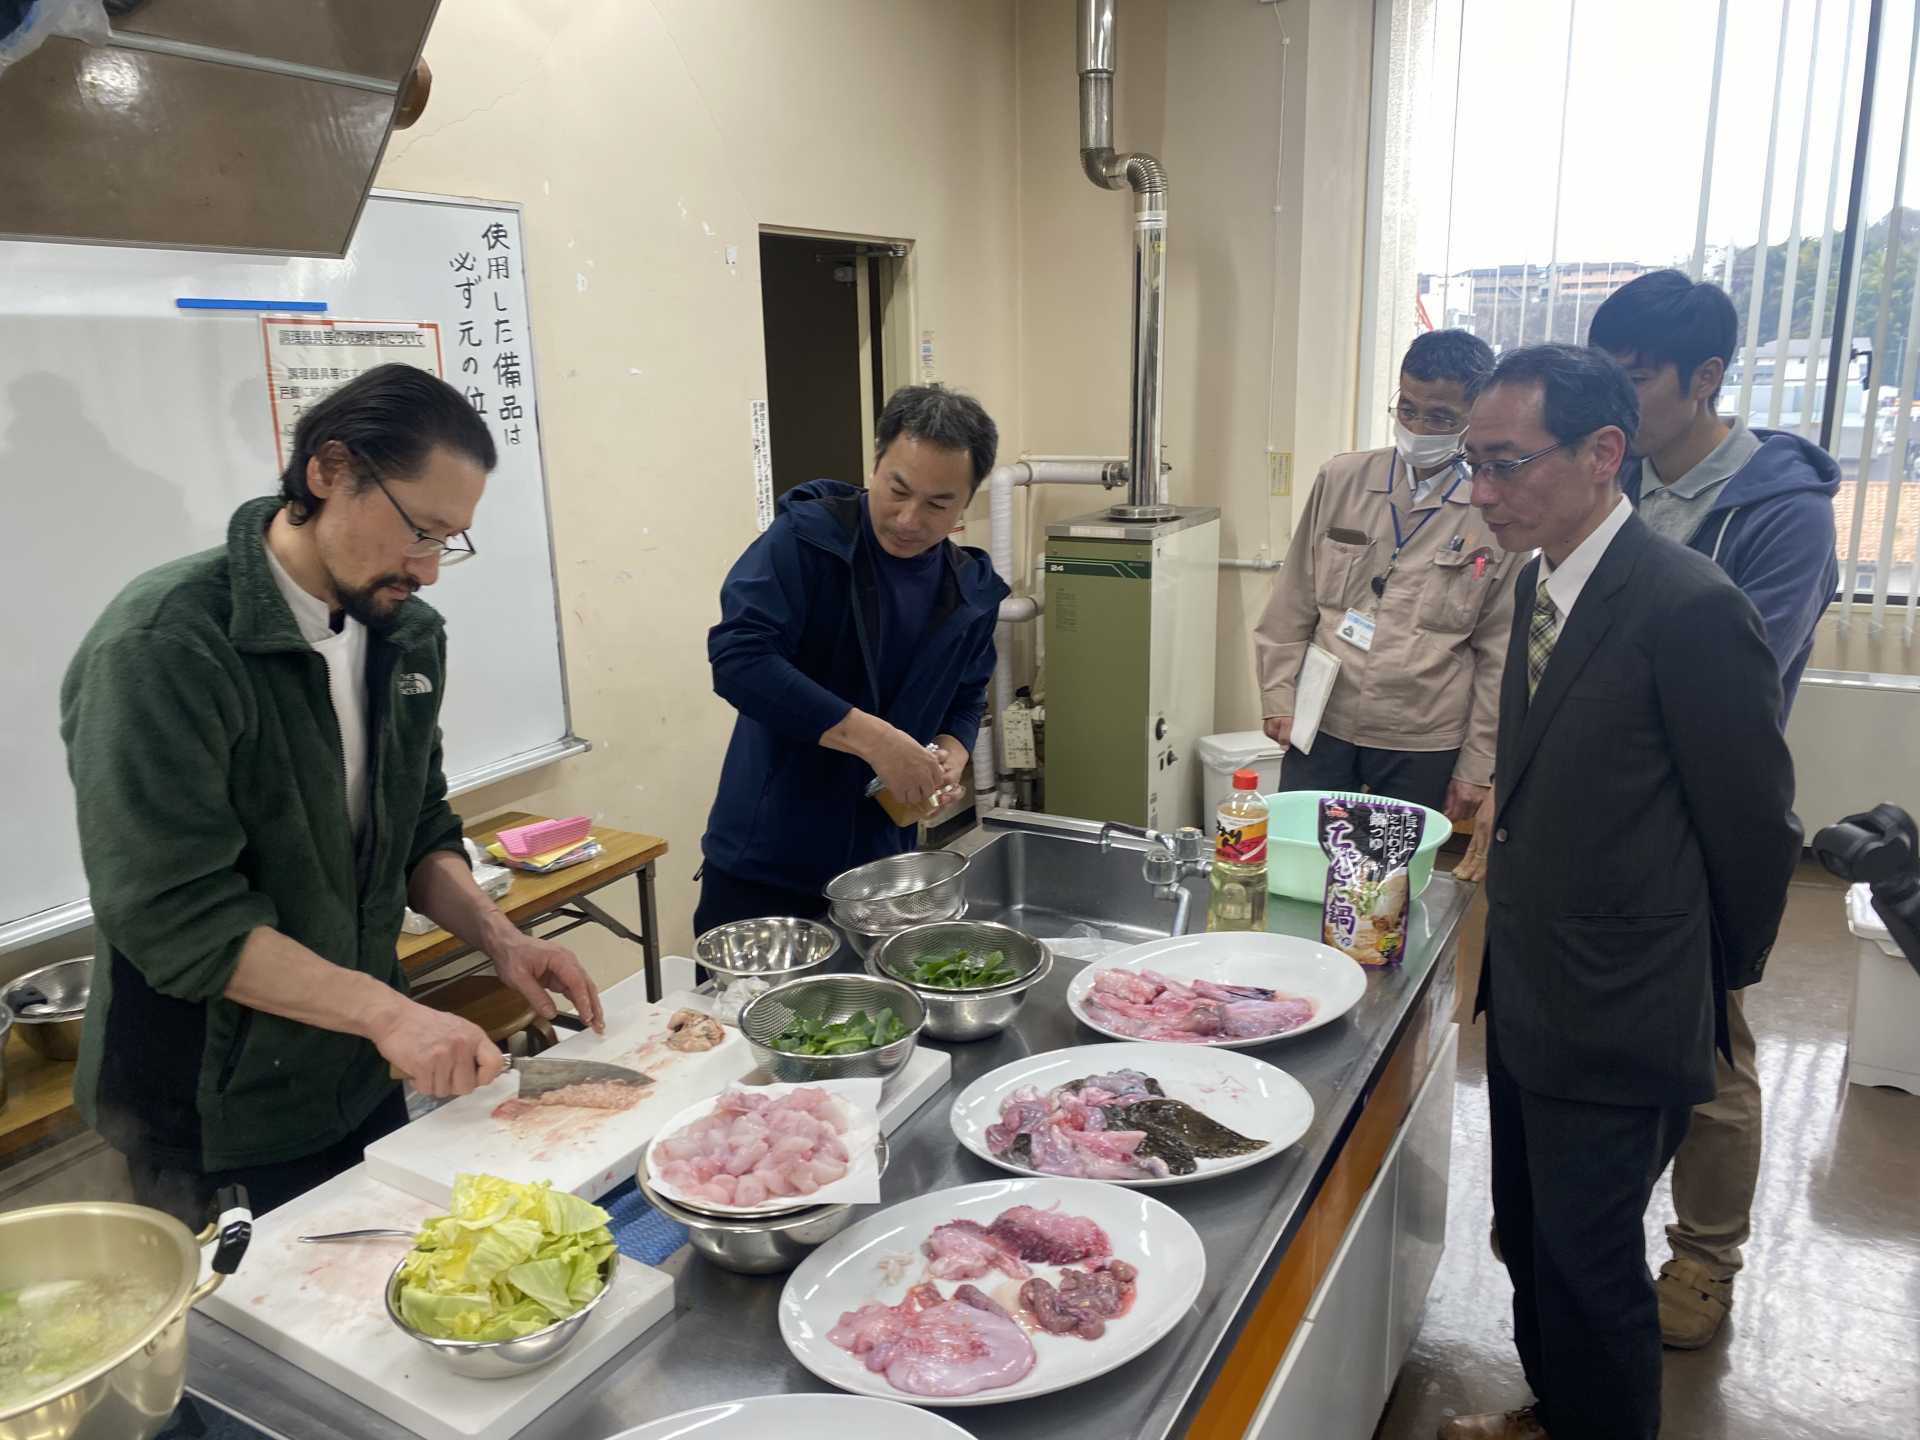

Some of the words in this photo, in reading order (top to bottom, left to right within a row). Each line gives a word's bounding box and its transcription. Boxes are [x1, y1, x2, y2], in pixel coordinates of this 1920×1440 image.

[482, 222, 523, 446] 使用した備品は
